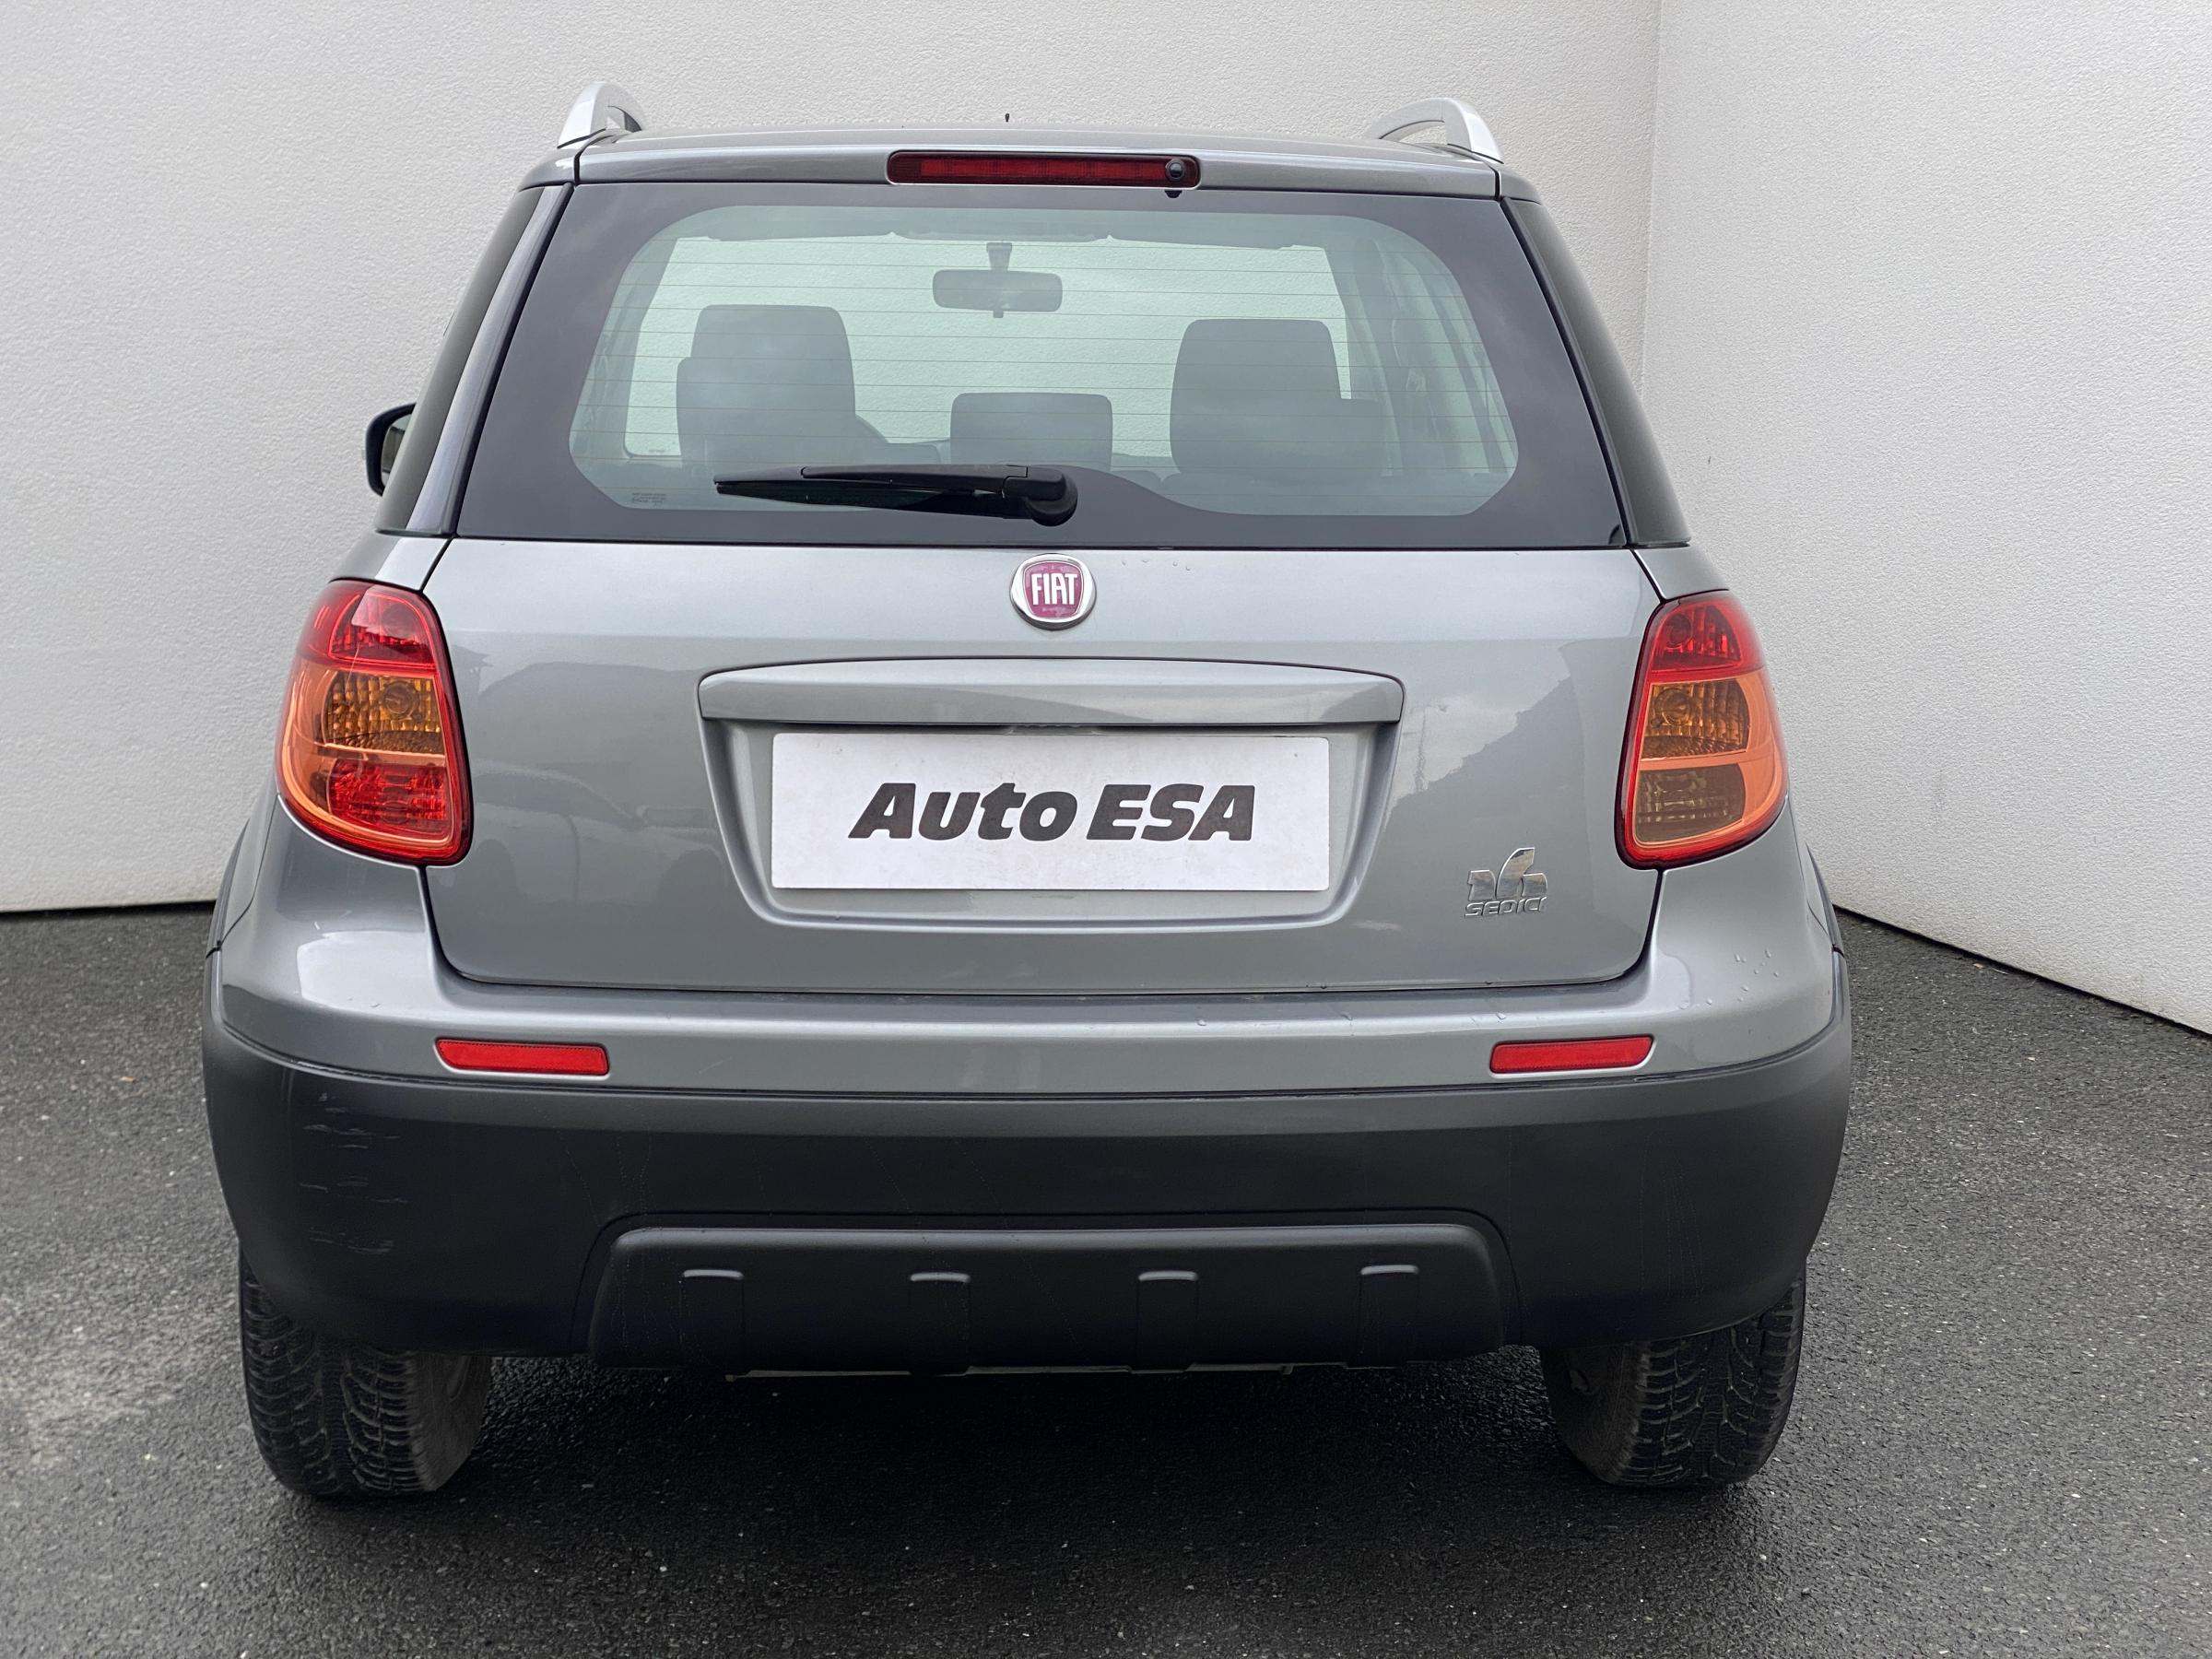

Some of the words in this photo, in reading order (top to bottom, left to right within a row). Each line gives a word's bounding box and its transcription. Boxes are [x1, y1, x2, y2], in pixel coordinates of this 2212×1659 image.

[1031, 573, 1077, 606] FIAT
[848, 782, 1077, 841] Auto
[1086, 783, 1255, 841] ESA
[1465, 897, 1547, 916] SEDICI
